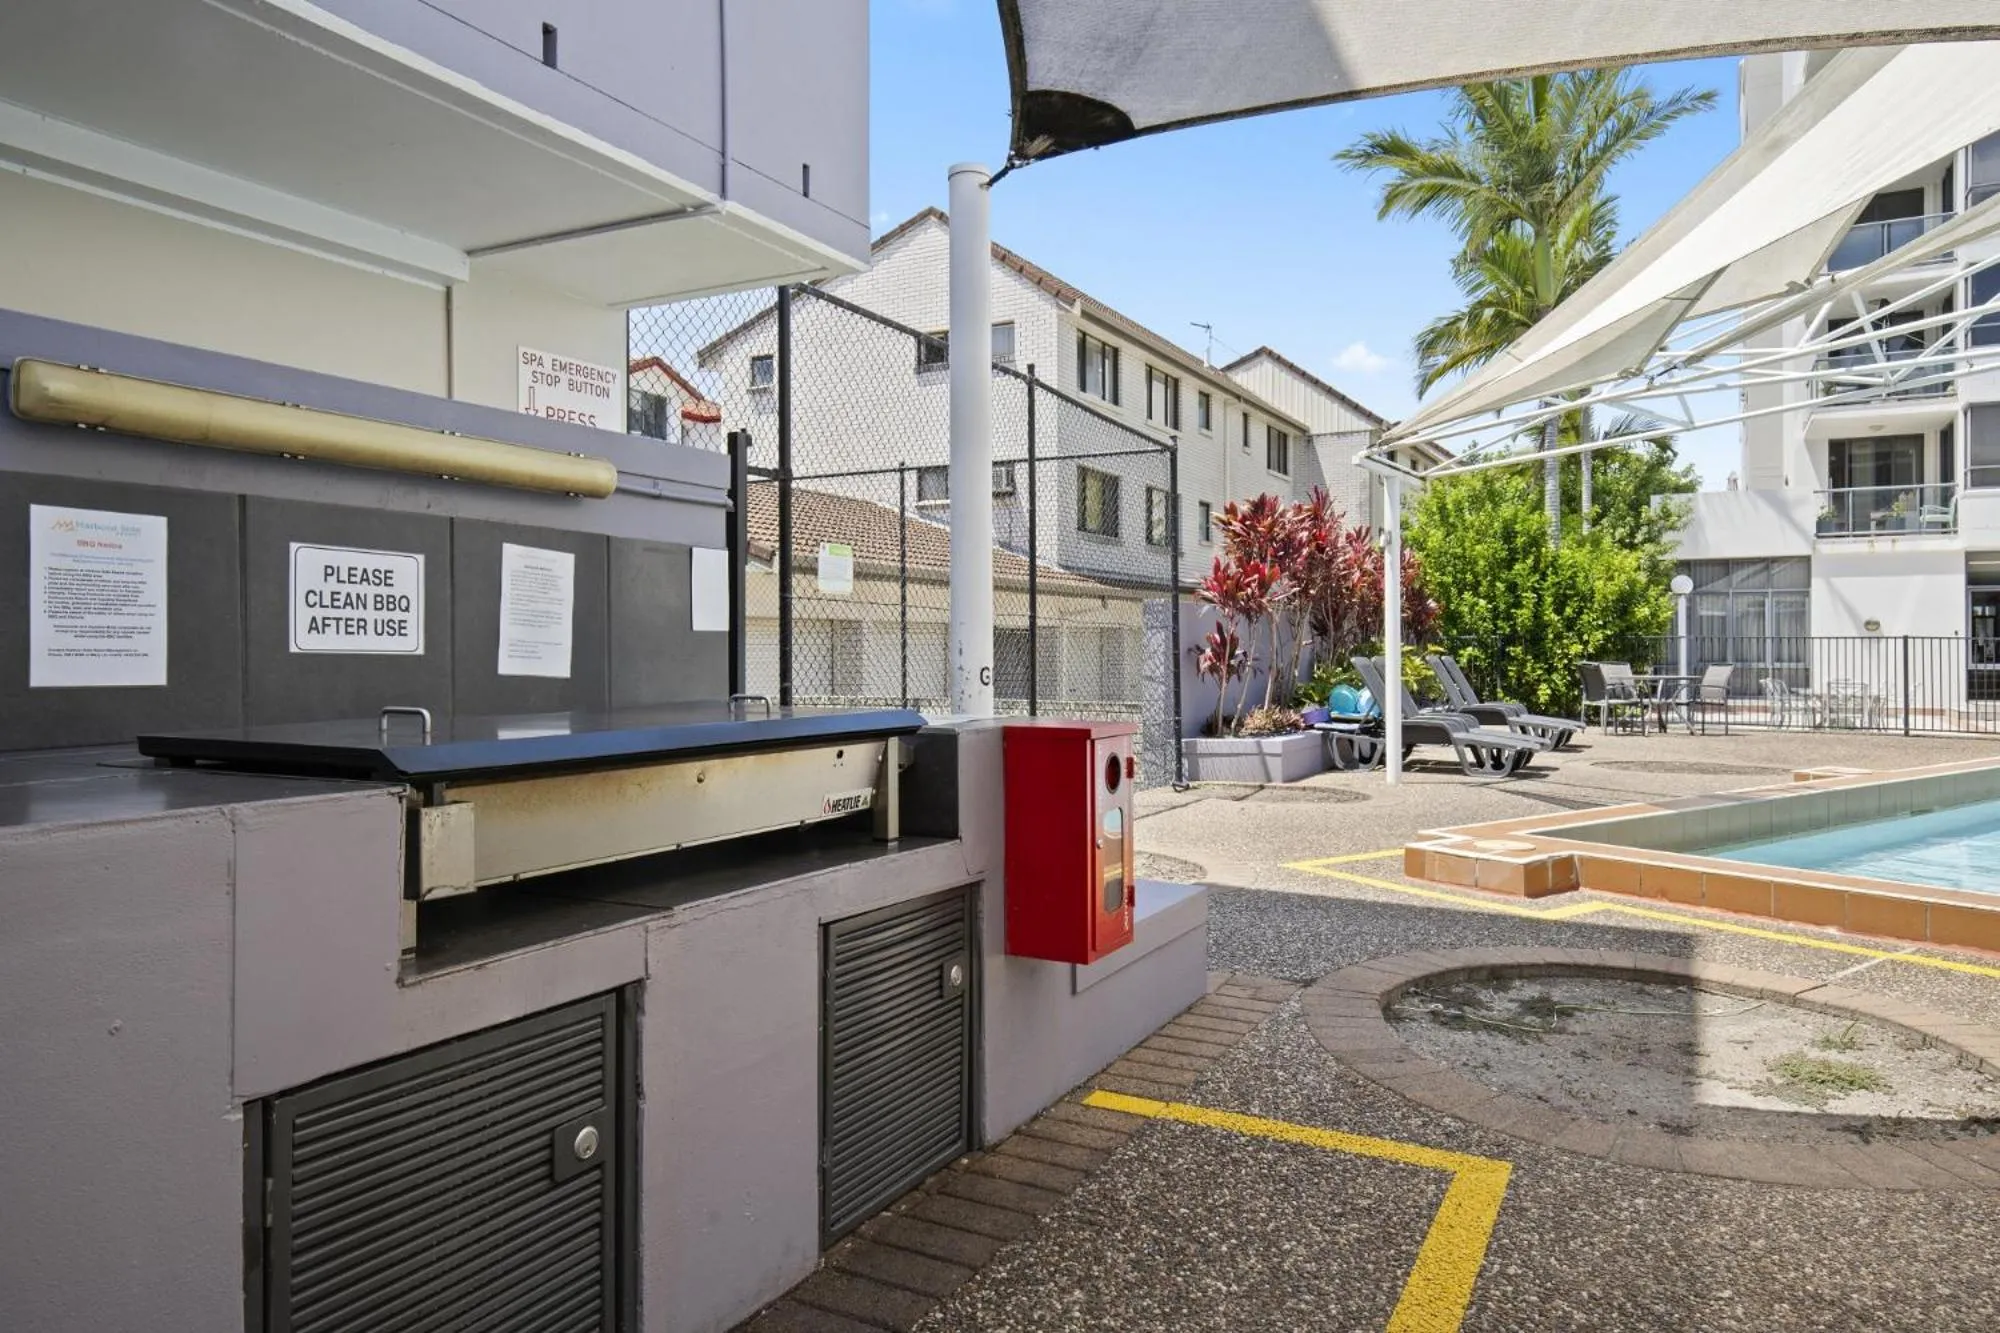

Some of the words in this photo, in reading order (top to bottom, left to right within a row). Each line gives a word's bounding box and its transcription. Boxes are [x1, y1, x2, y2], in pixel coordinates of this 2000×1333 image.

[522, 351, 545, 368] SPA
[551, 358, 617, 384] EMERGENCY
[531, 370, 561, 388] STOP
[568, 378, 610, 399] BUTTON
[545, 406, 597, 427] PRESS
[323, 564, 395, 587] PLEASE
[305, 589, 368, 611] CLEAN
[373, 594, 411, 614] BBQ
[307, 615, 368, 636] AFTER
[374, 618, 409, 637] USE
[980, 666, 991, 686] G
[831, 795, 861, 813] HEATLIE
